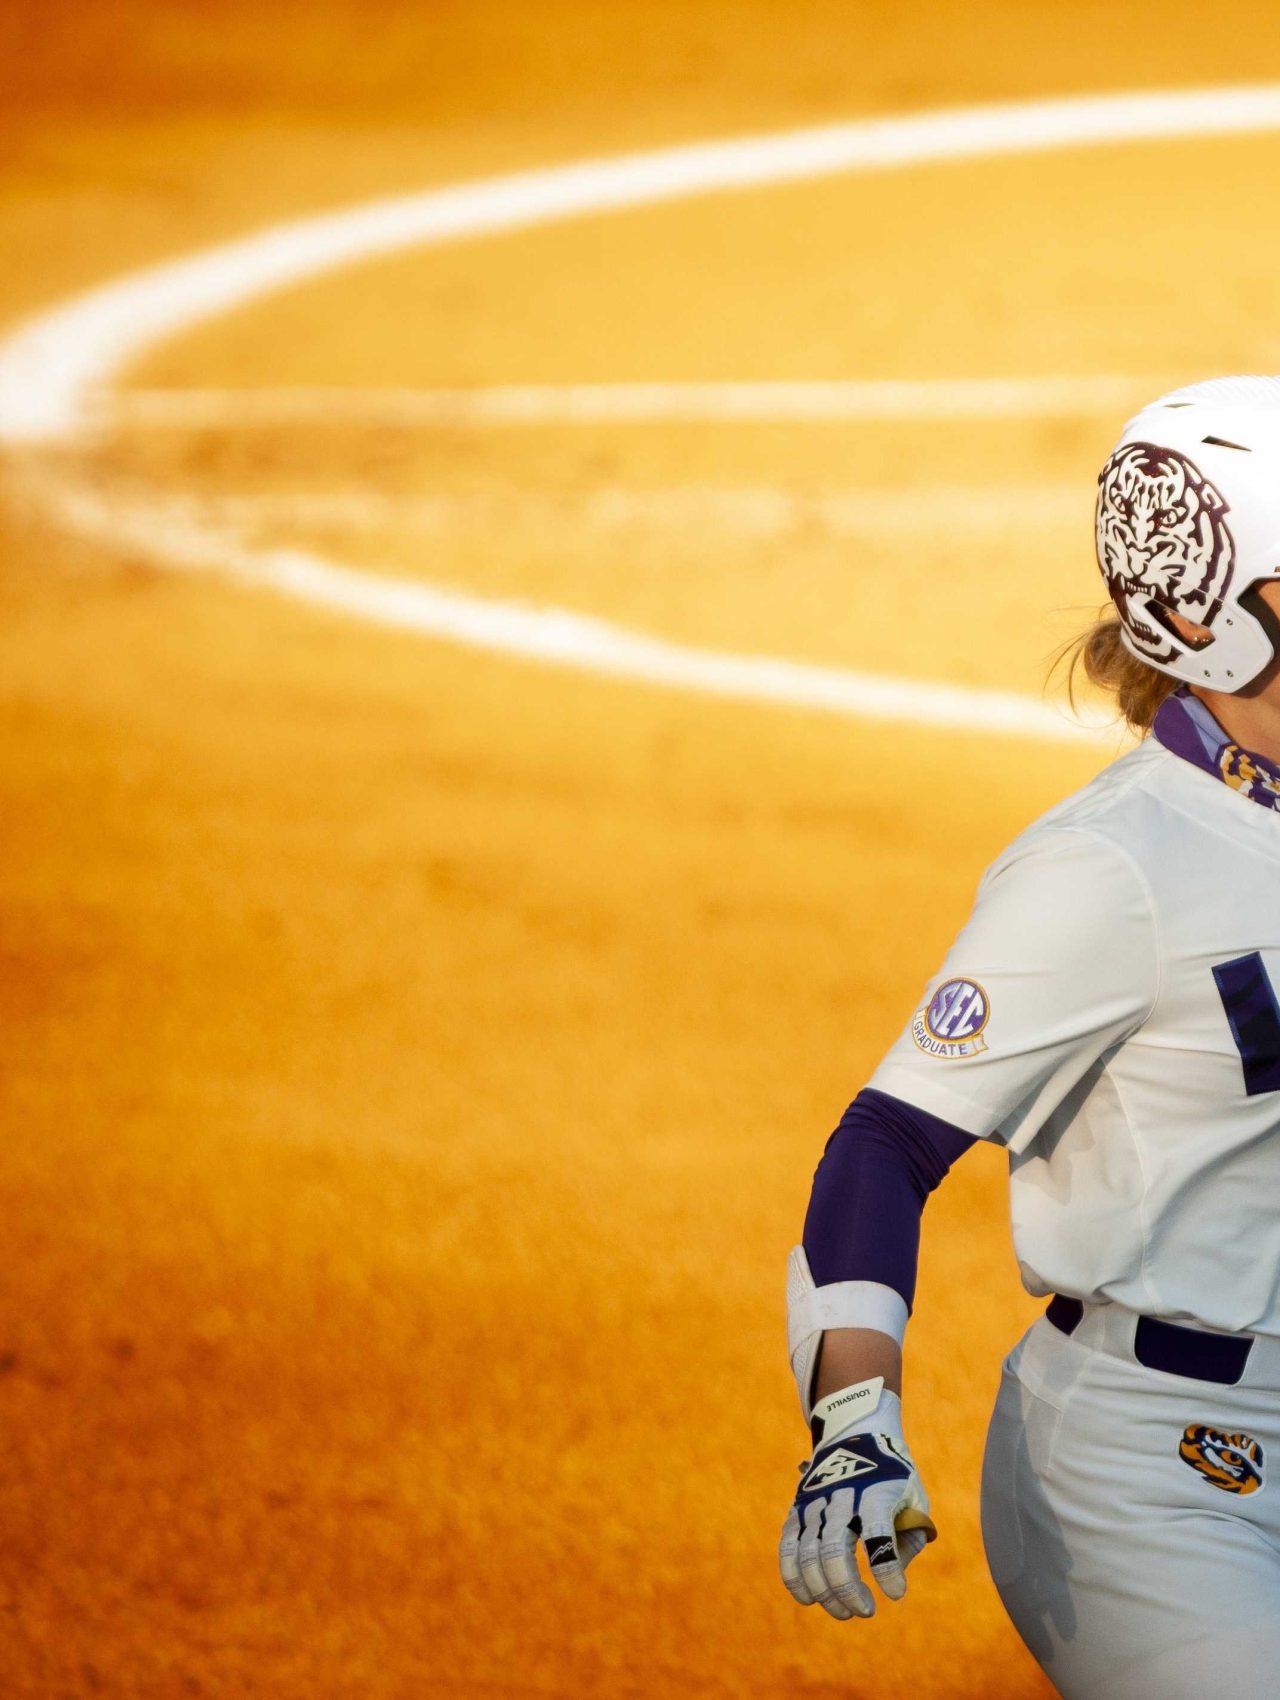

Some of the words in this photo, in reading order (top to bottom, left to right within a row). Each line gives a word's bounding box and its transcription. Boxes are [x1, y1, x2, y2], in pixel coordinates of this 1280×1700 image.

[929, 982, 984, 1037] SEC
[914, 1021, 968, 1056] GRADUATE
[827, 1388, 871, 1412] LOUISVILLE
